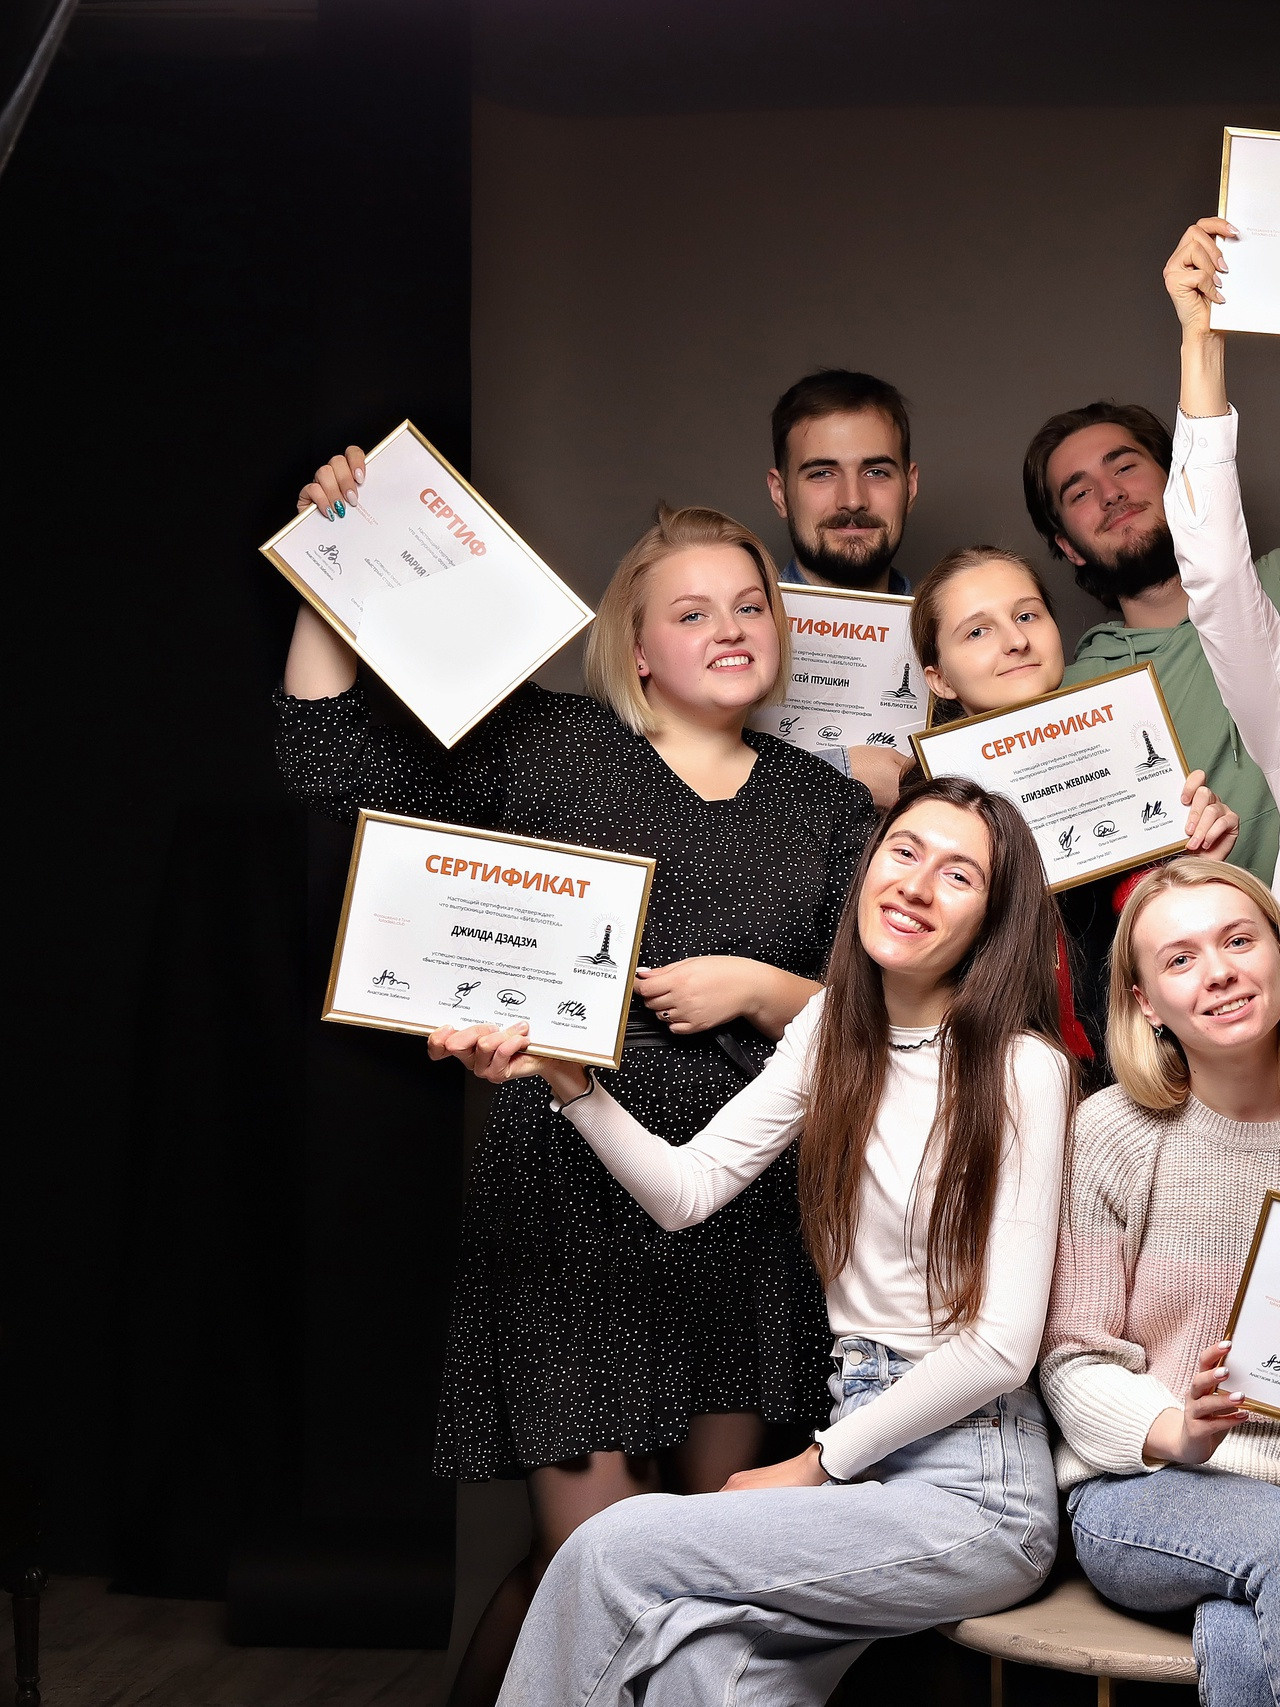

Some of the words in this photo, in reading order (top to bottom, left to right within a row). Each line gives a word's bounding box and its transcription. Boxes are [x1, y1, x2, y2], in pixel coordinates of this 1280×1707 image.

[419, 488, 486, 556] СЕРТИФ
[400, 550, 426, 576] МАРИЯ
[787, 616, 889, 642] ТИФИКАТ
[810, 675, 849, 687] ПТУШКИН
[879, 701, 917, 709] БИБЛИОТЕКА
[981, 704, 1113, 760] СЕРТИФИКАТ
[1020, 782, 1064, 803] ЕЛИЗАВЕТА
[1063, 767, 1111, 789] ЖЕВЛАКОВА
[1137, 767, 1172, 782] БИБЛИОТЕКА
[425, 854, 590, 898] СЕРТИФИКАТ
[450, 925, 493, 942] ДЖИЛДА
[494, 932, 537, 948] ДЗАДЗУА
[573, 967, 616, 979] БИБЛИОТЕКА
